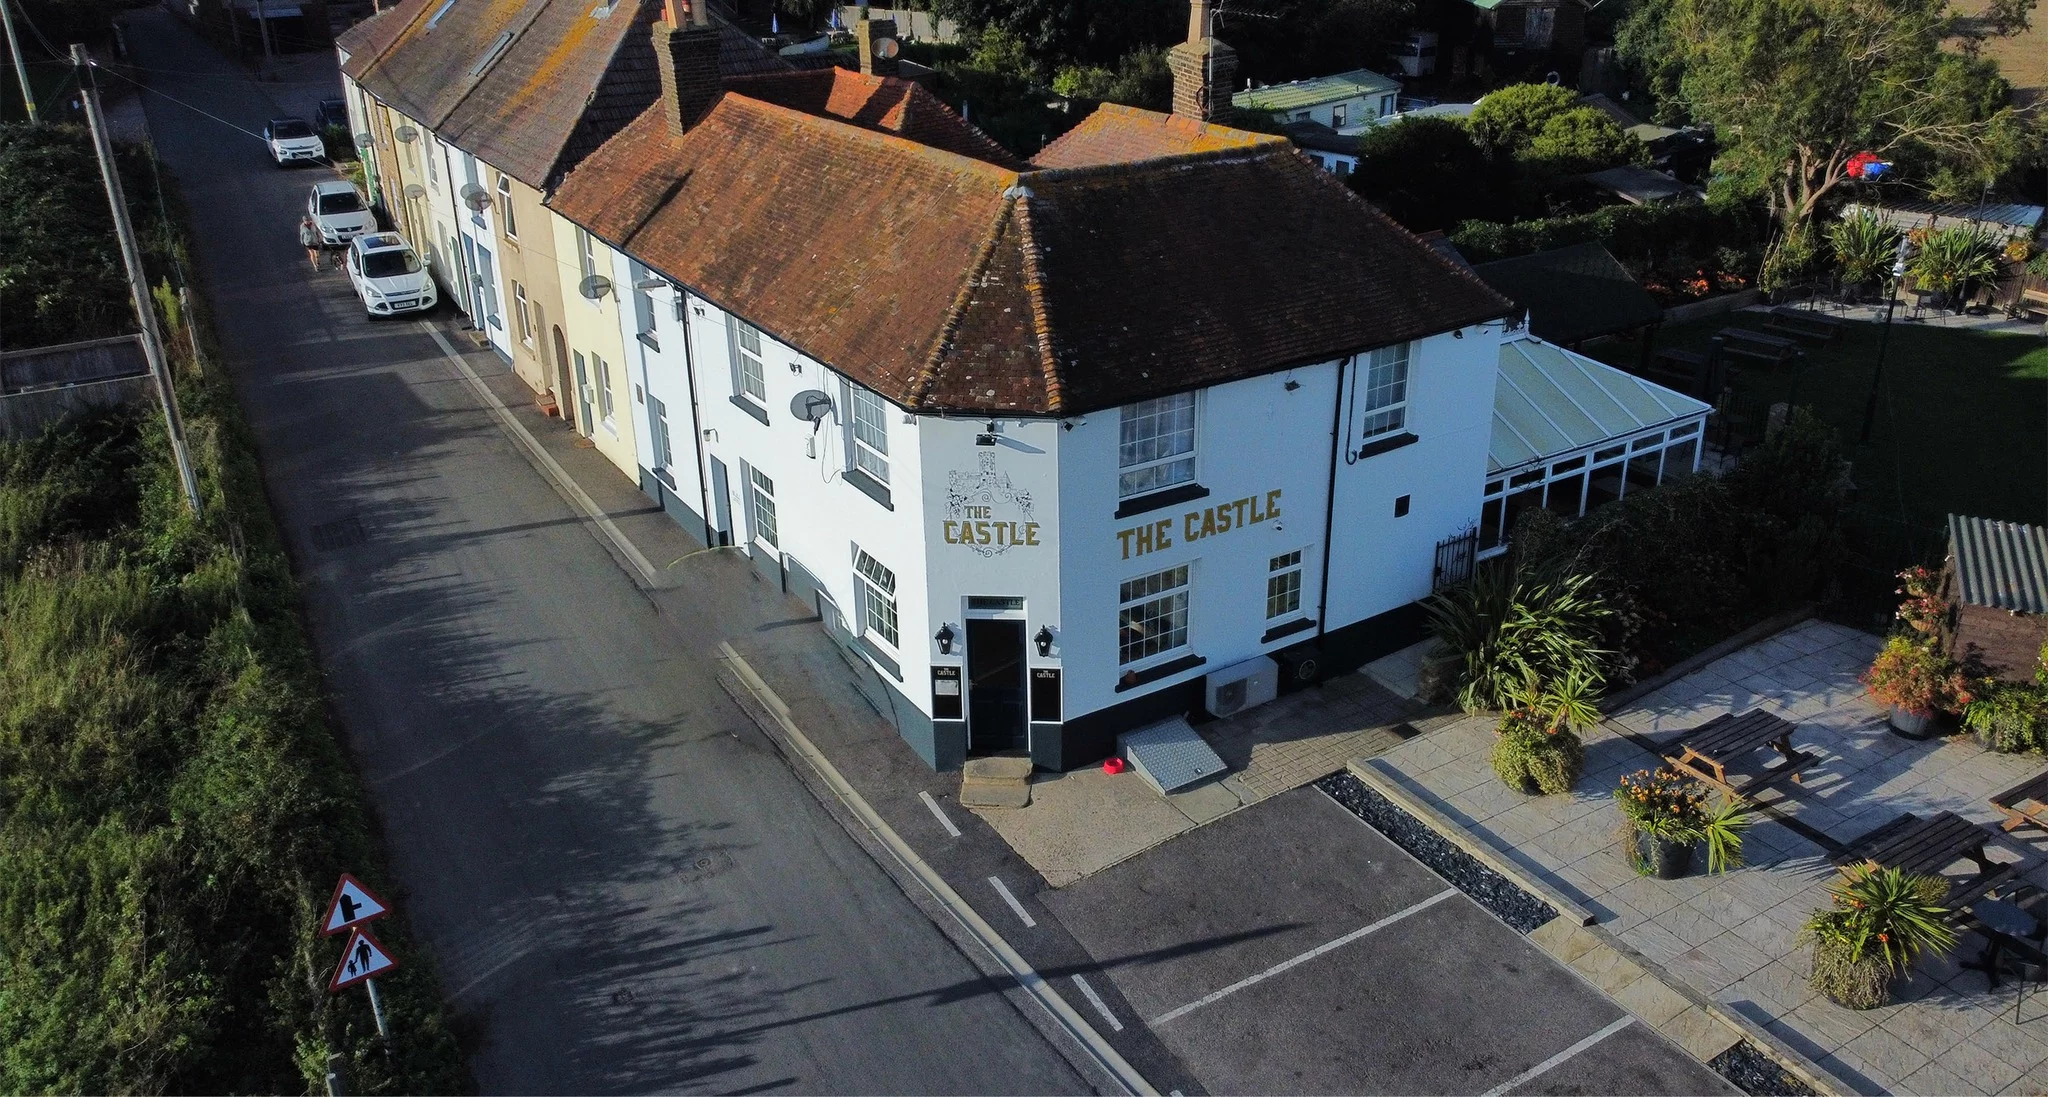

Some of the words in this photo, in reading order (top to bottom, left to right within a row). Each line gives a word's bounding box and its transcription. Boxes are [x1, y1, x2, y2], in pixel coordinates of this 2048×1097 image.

[964, 505, 992, 519] THE
[1116, 518, 1172, 560] THE
[1184, 488, 1282, 542] CASTLE
[943, 520, 1041, 546] CASTLE
